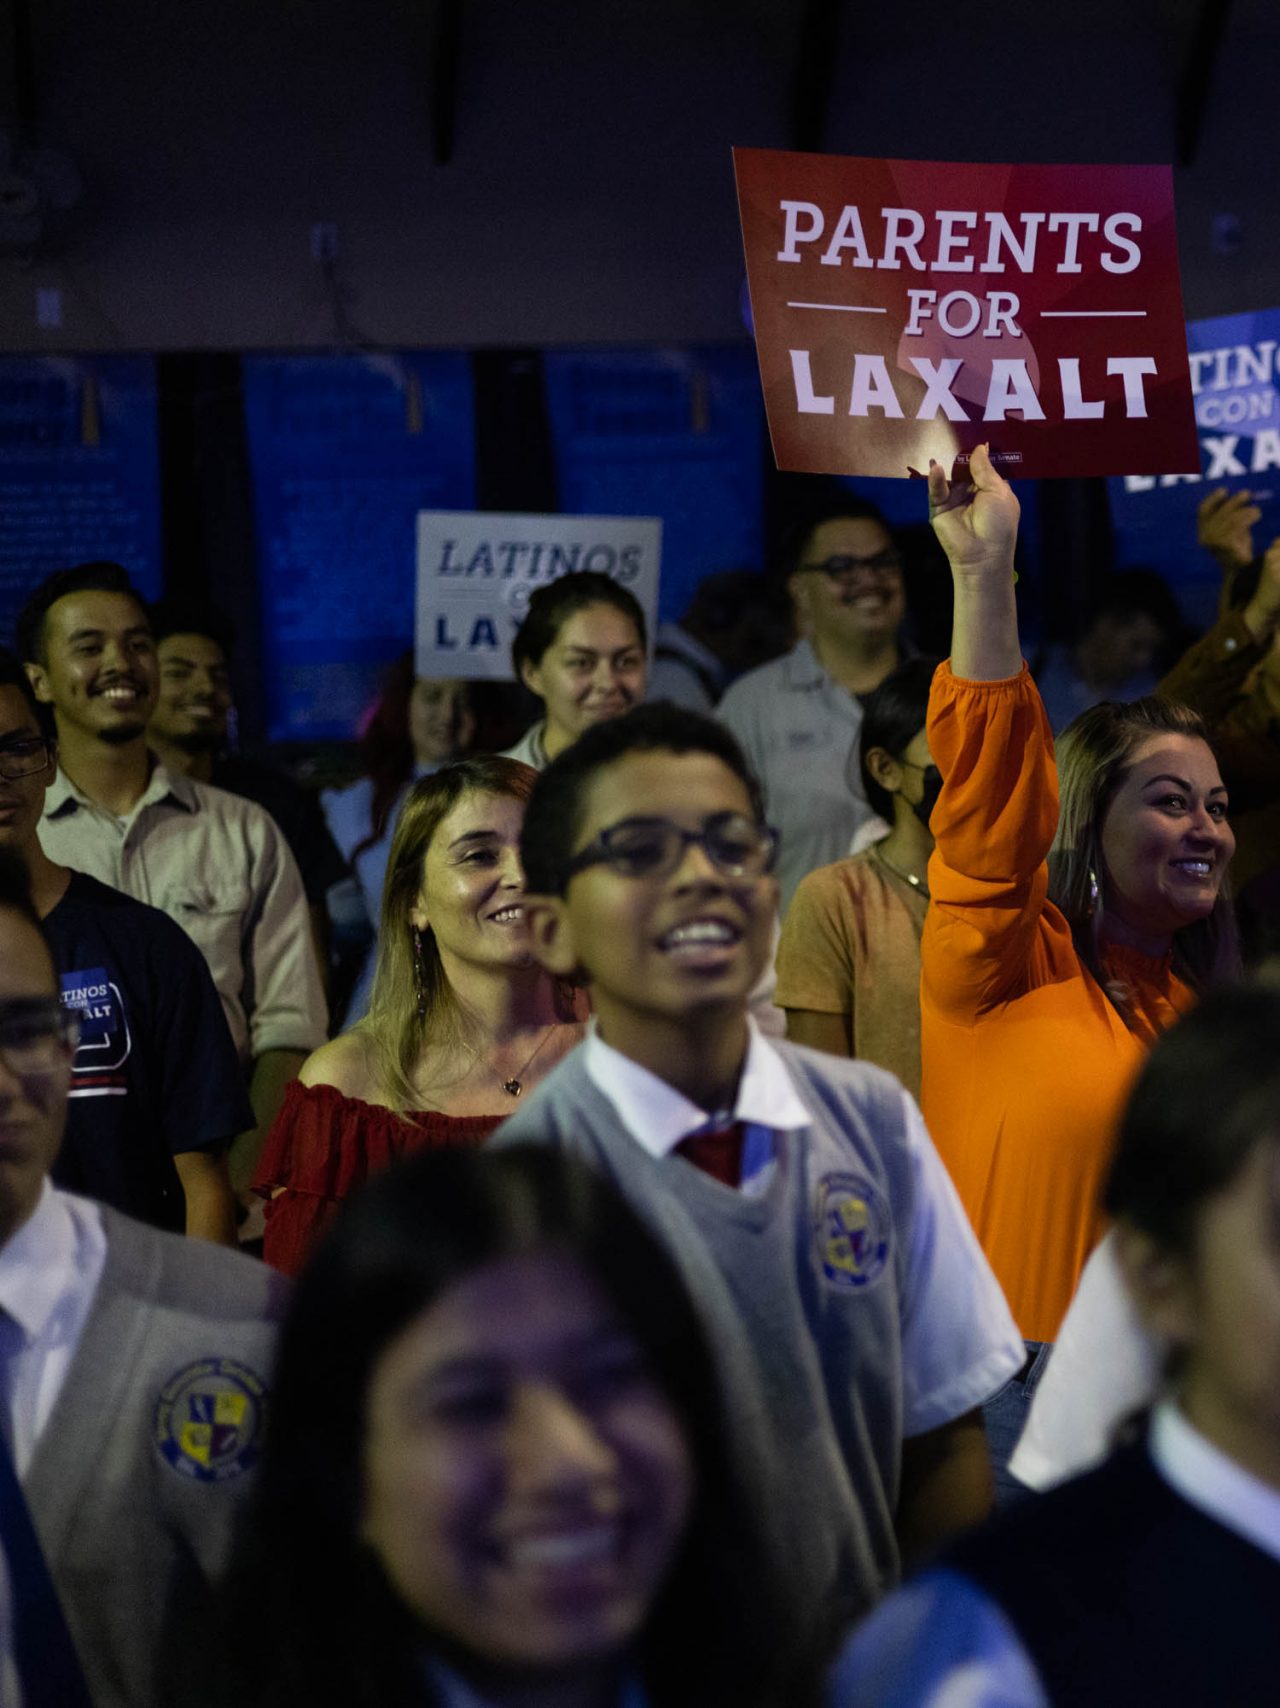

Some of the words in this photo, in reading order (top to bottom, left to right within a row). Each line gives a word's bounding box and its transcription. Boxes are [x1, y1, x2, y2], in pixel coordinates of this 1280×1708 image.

[777, 200, 1142, 274] PARENTS
[905, 289, 1021, 338] FOR
[788, 349, 1158, 422] LAXALT
[1201, 388, 1275, 428] CON
[438, 539, 642, 582] LATINOS
[60, 984, 107, 1003] TINOS
